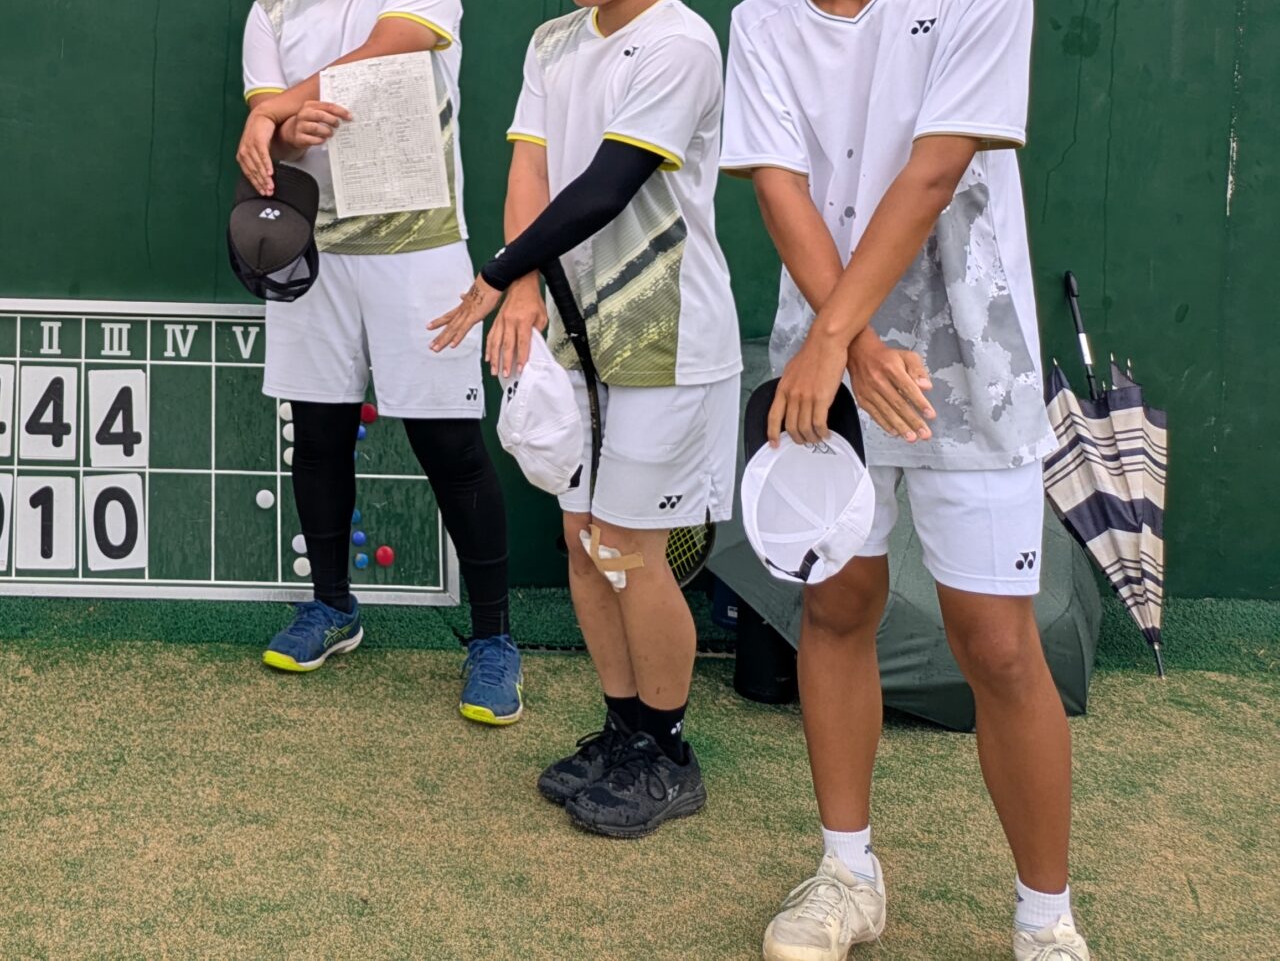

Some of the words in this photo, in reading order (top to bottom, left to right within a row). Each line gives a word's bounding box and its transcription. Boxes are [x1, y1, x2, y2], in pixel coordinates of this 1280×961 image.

[24, 376, 73, 449] 4
[95, 386, 143, 458] 4
[29, 486, 55, 560] 1
[93, 486, 139, 561] 0
